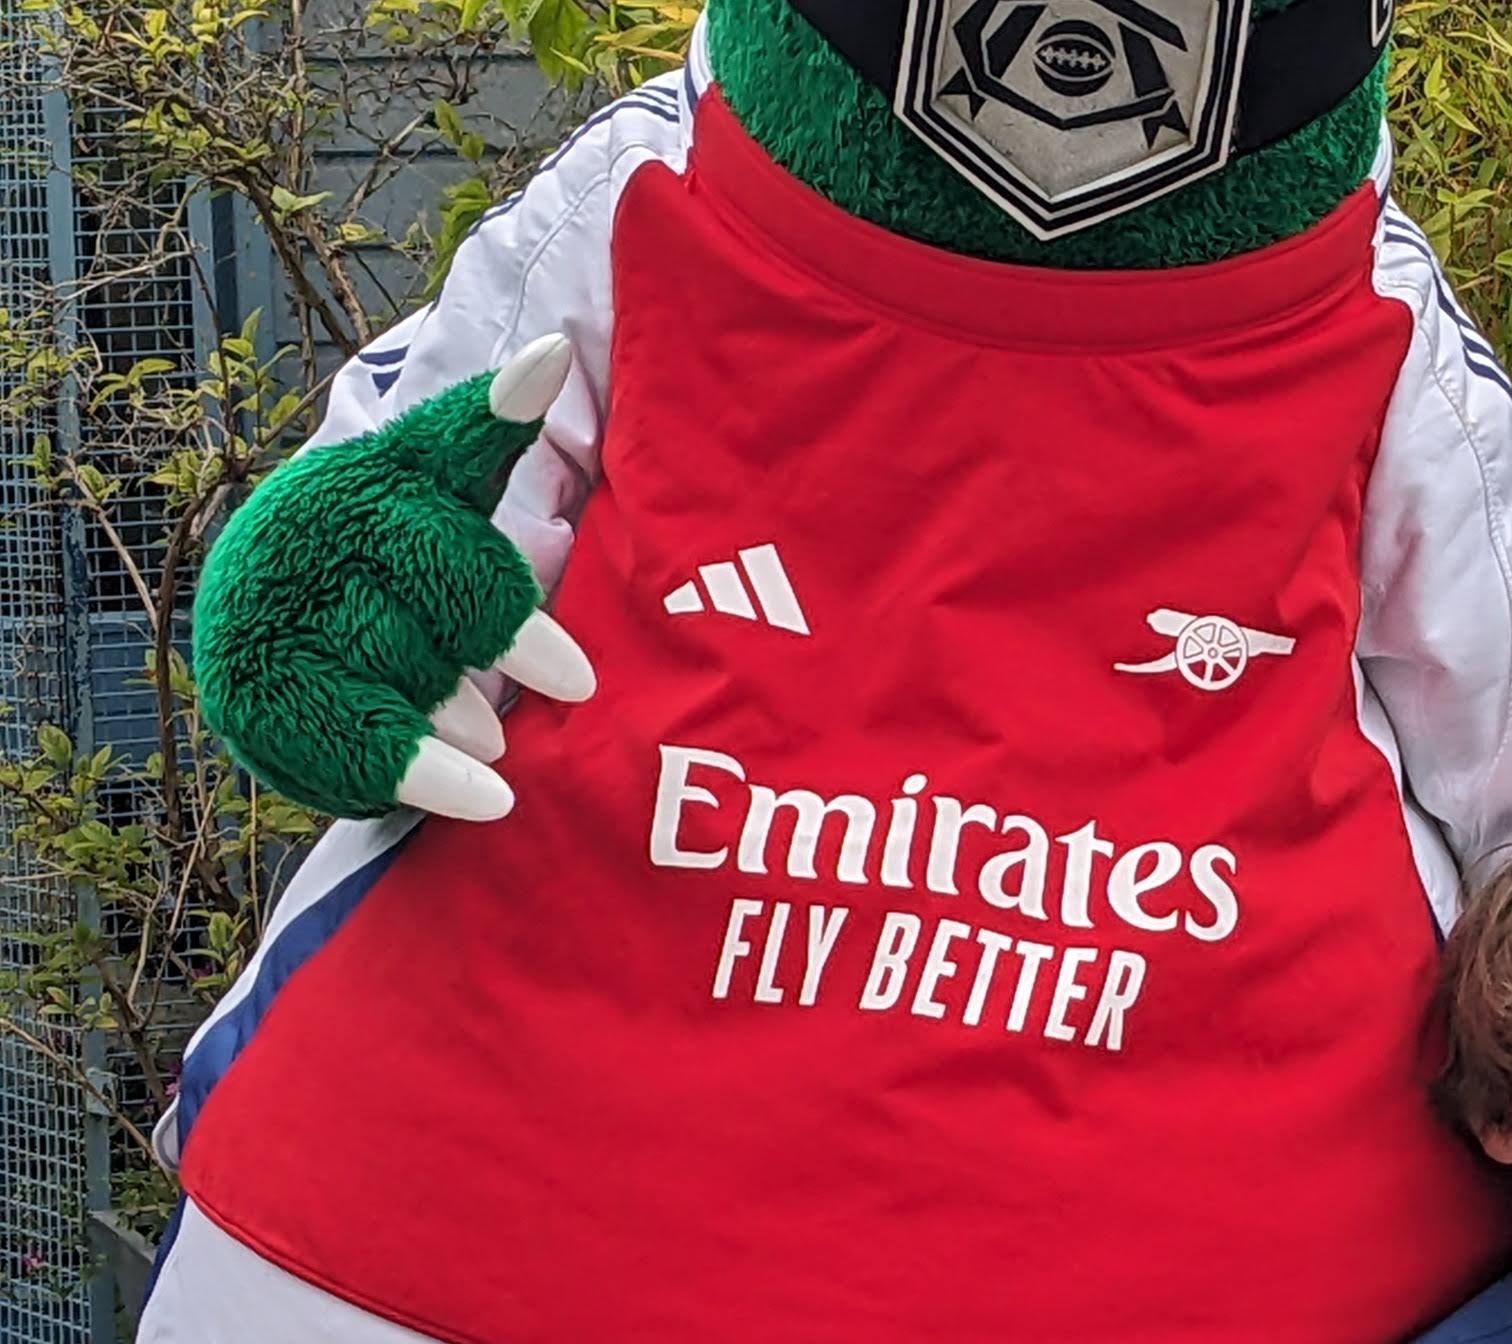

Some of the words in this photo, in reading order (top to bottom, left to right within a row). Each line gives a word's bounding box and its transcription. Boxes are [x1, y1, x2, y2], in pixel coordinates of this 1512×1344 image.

[649, 743, 1239, 942] Emirates
[712, 898, 849, 1007] FLY
[859, 911, 1147, 1052] BETTER
